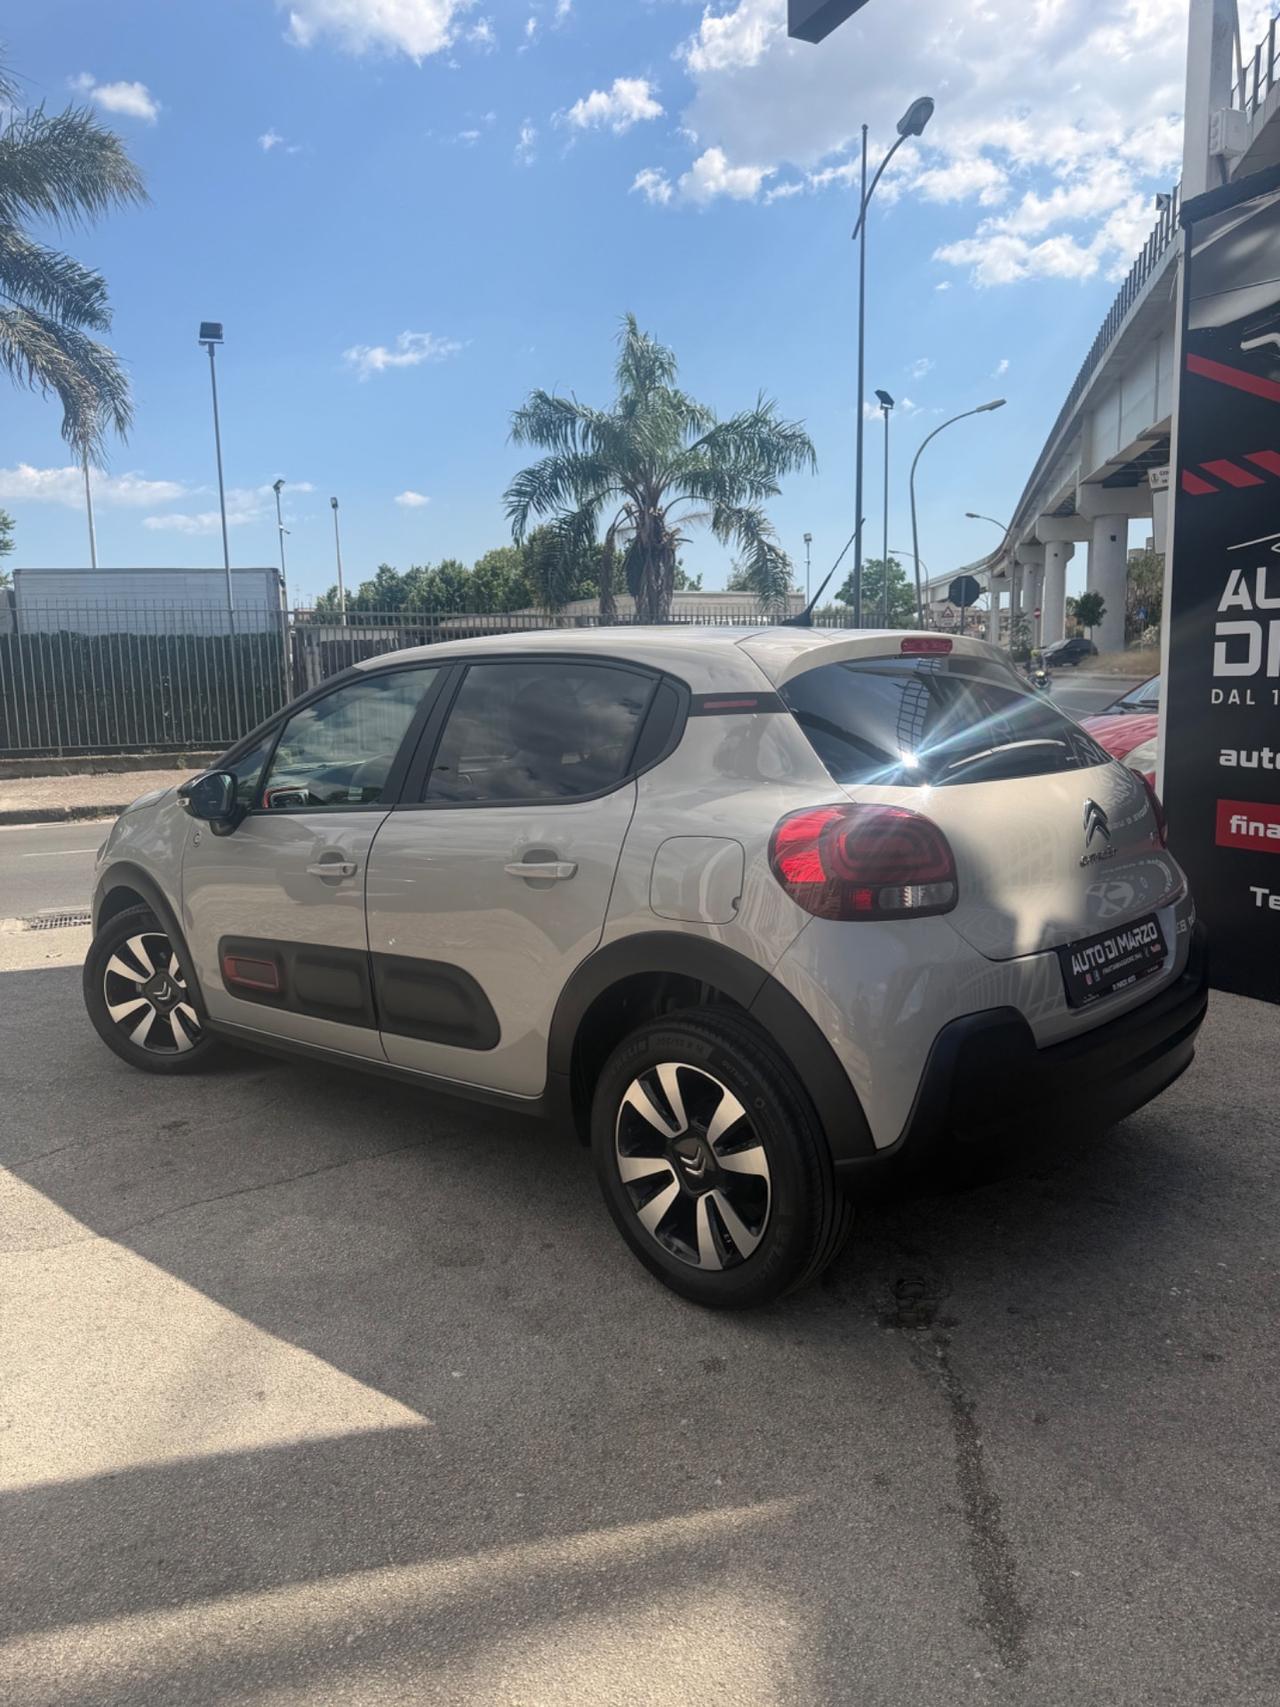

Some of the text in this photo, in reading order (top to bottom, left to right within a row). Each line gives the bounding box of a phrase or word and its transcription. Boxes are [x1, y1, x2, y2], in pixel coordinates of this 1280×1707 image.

[1211, 688, 1256, 705] DAL
[1071, 943, 1105, 976] AUTO
[1104, 937, 1118, 959] DI
[1116, 921, 1158, 954] MARZO
